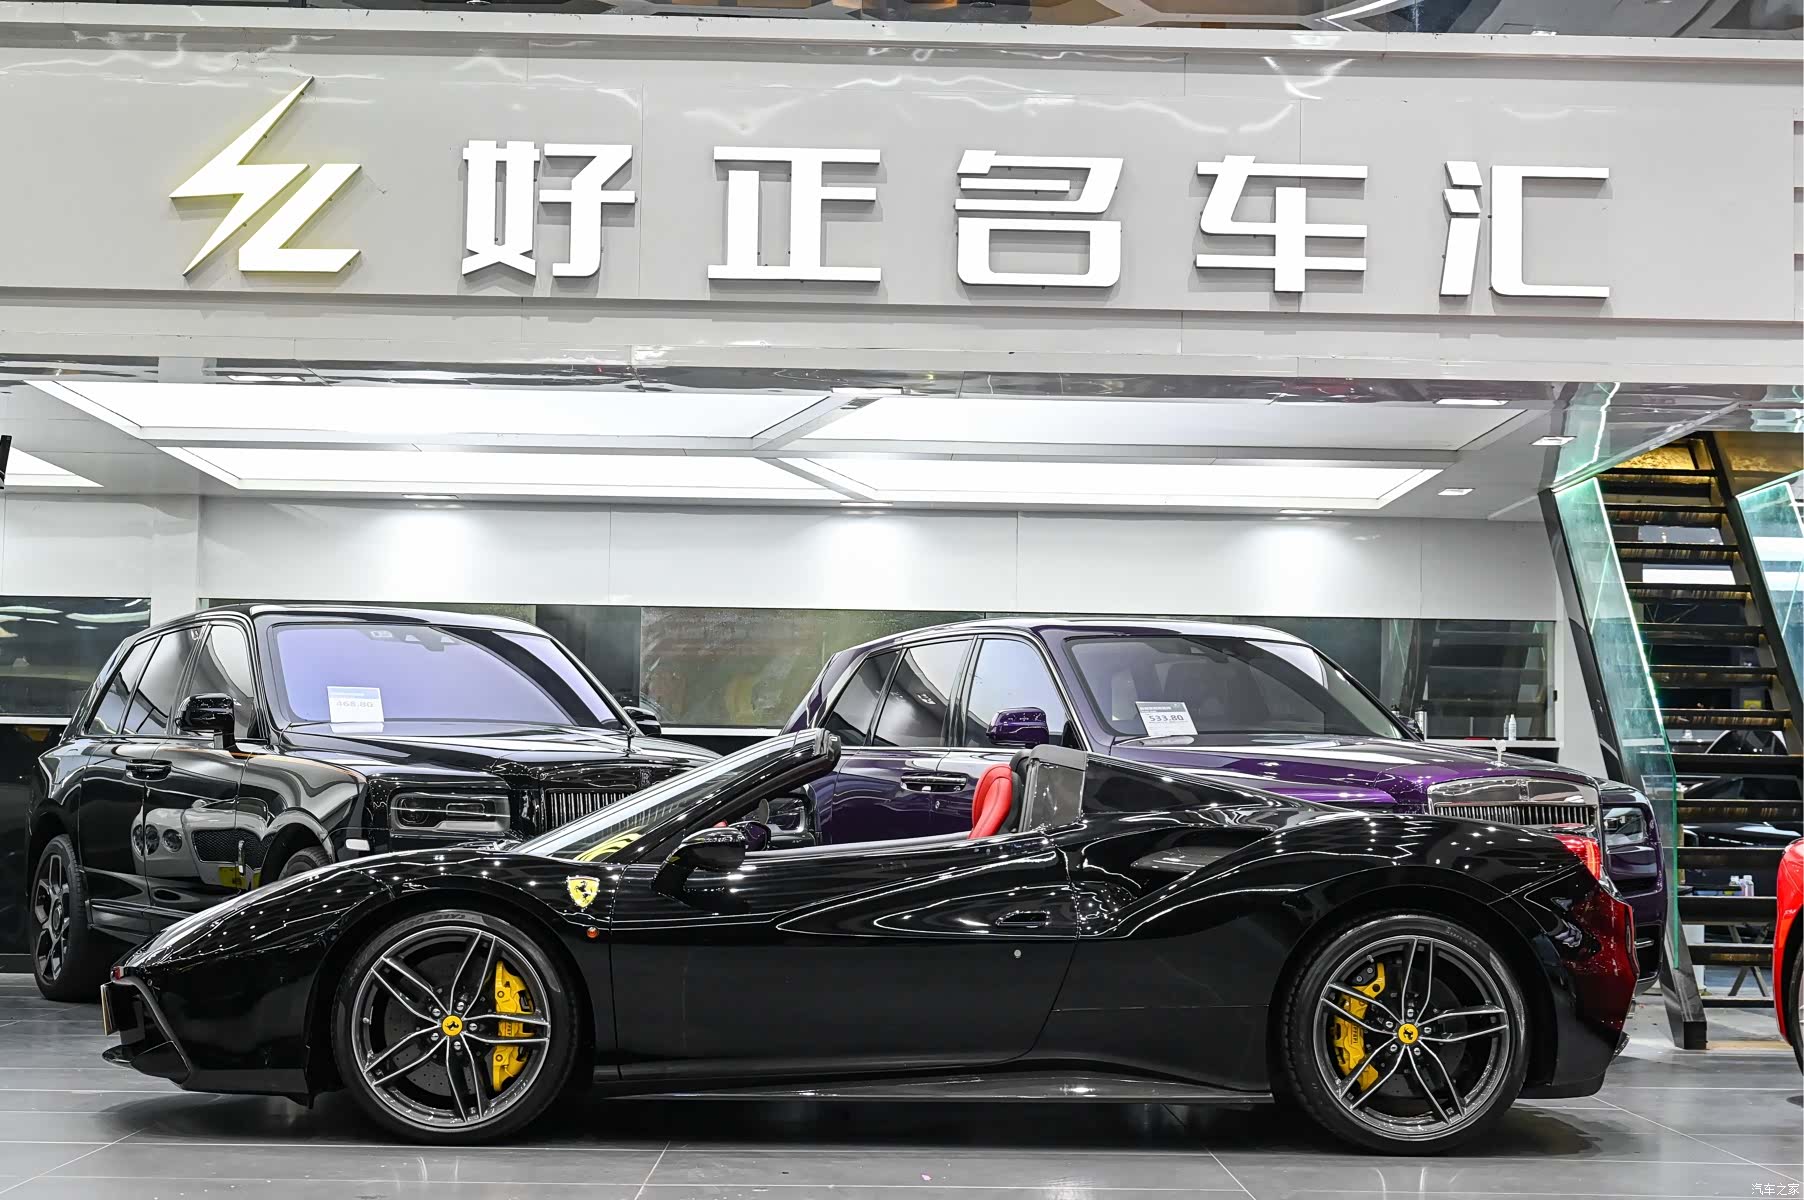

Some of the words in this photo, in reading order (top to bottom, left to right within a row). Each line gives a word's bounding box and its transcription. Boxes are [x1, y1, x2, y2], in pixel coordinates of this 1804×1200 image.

[462, 140, 1610, 298] 好正名车汇
